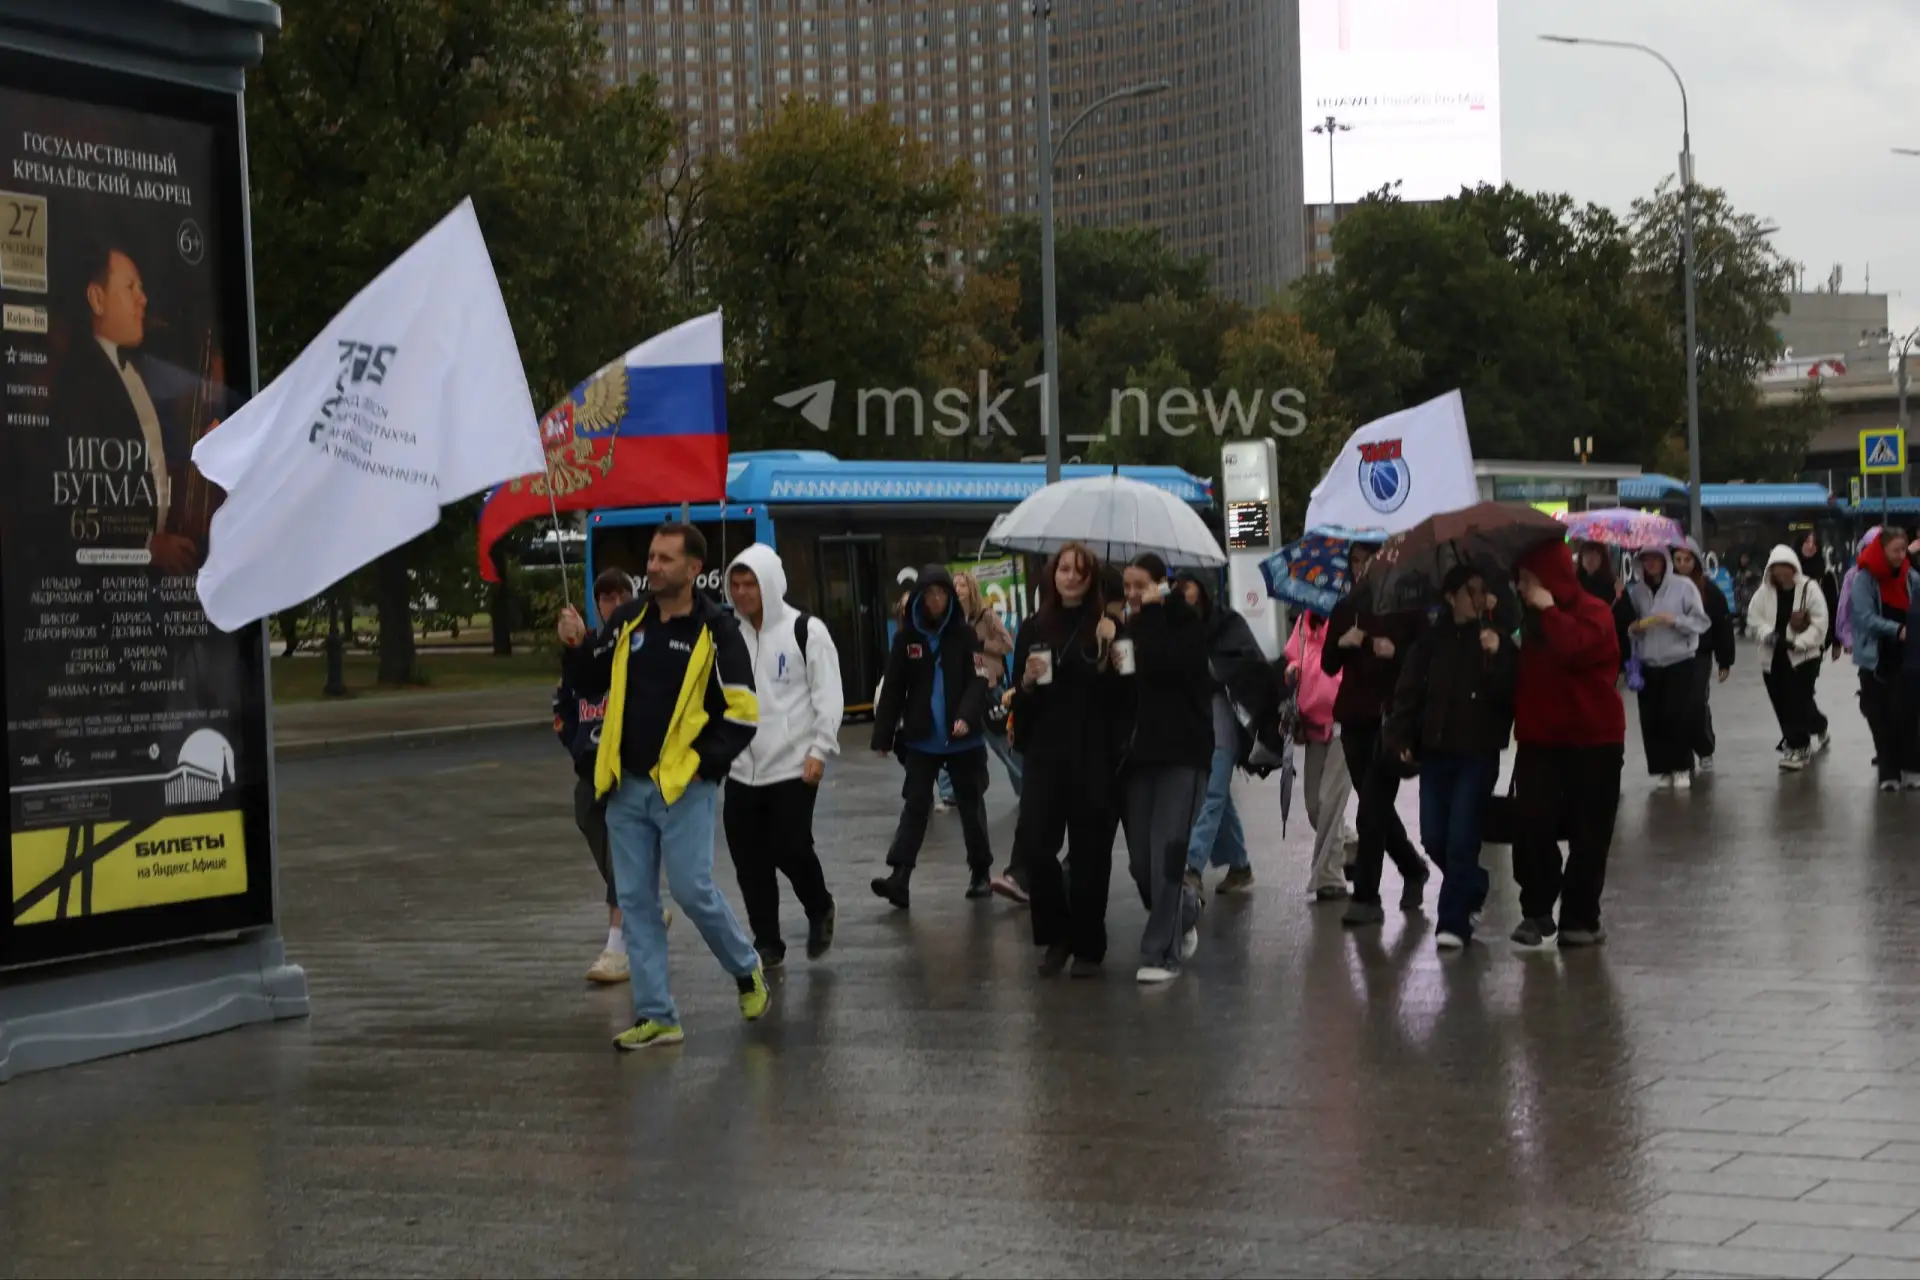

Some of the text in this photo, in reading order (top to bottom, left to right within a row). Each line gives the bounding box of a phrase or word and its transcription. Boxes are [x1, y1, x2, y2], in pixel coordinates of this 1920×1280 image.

[23, 131, 178, 177] ГОСУДАРСТВЕННЫЙ
[12, 158, 192, 207] КРЕМЛЁВСКИЙ ДВОРЕЦ
[8, 201, 38, 239] 27
[180, 227, 200, 253] 6+
[53, 471, 172, 507] БУТМАН
[70, 507, 100, 541] 65
[41, 576, 81, 590] ИЛЬДАР
[102, 575, 149, 589] ВАЛЕРИЙ
[40, 612, 80, 625] ВИКТОР
[112, 611, 152, 624] ЛАРИСА
[111, 624, 152, 640] ДОЛИНА
[71, 645, 109, 660] СЕРГЕЙ
[135, 833, 225, 858] БИЛЕТЫ
[137, 857, 227, 880] на Яндекс Афише
